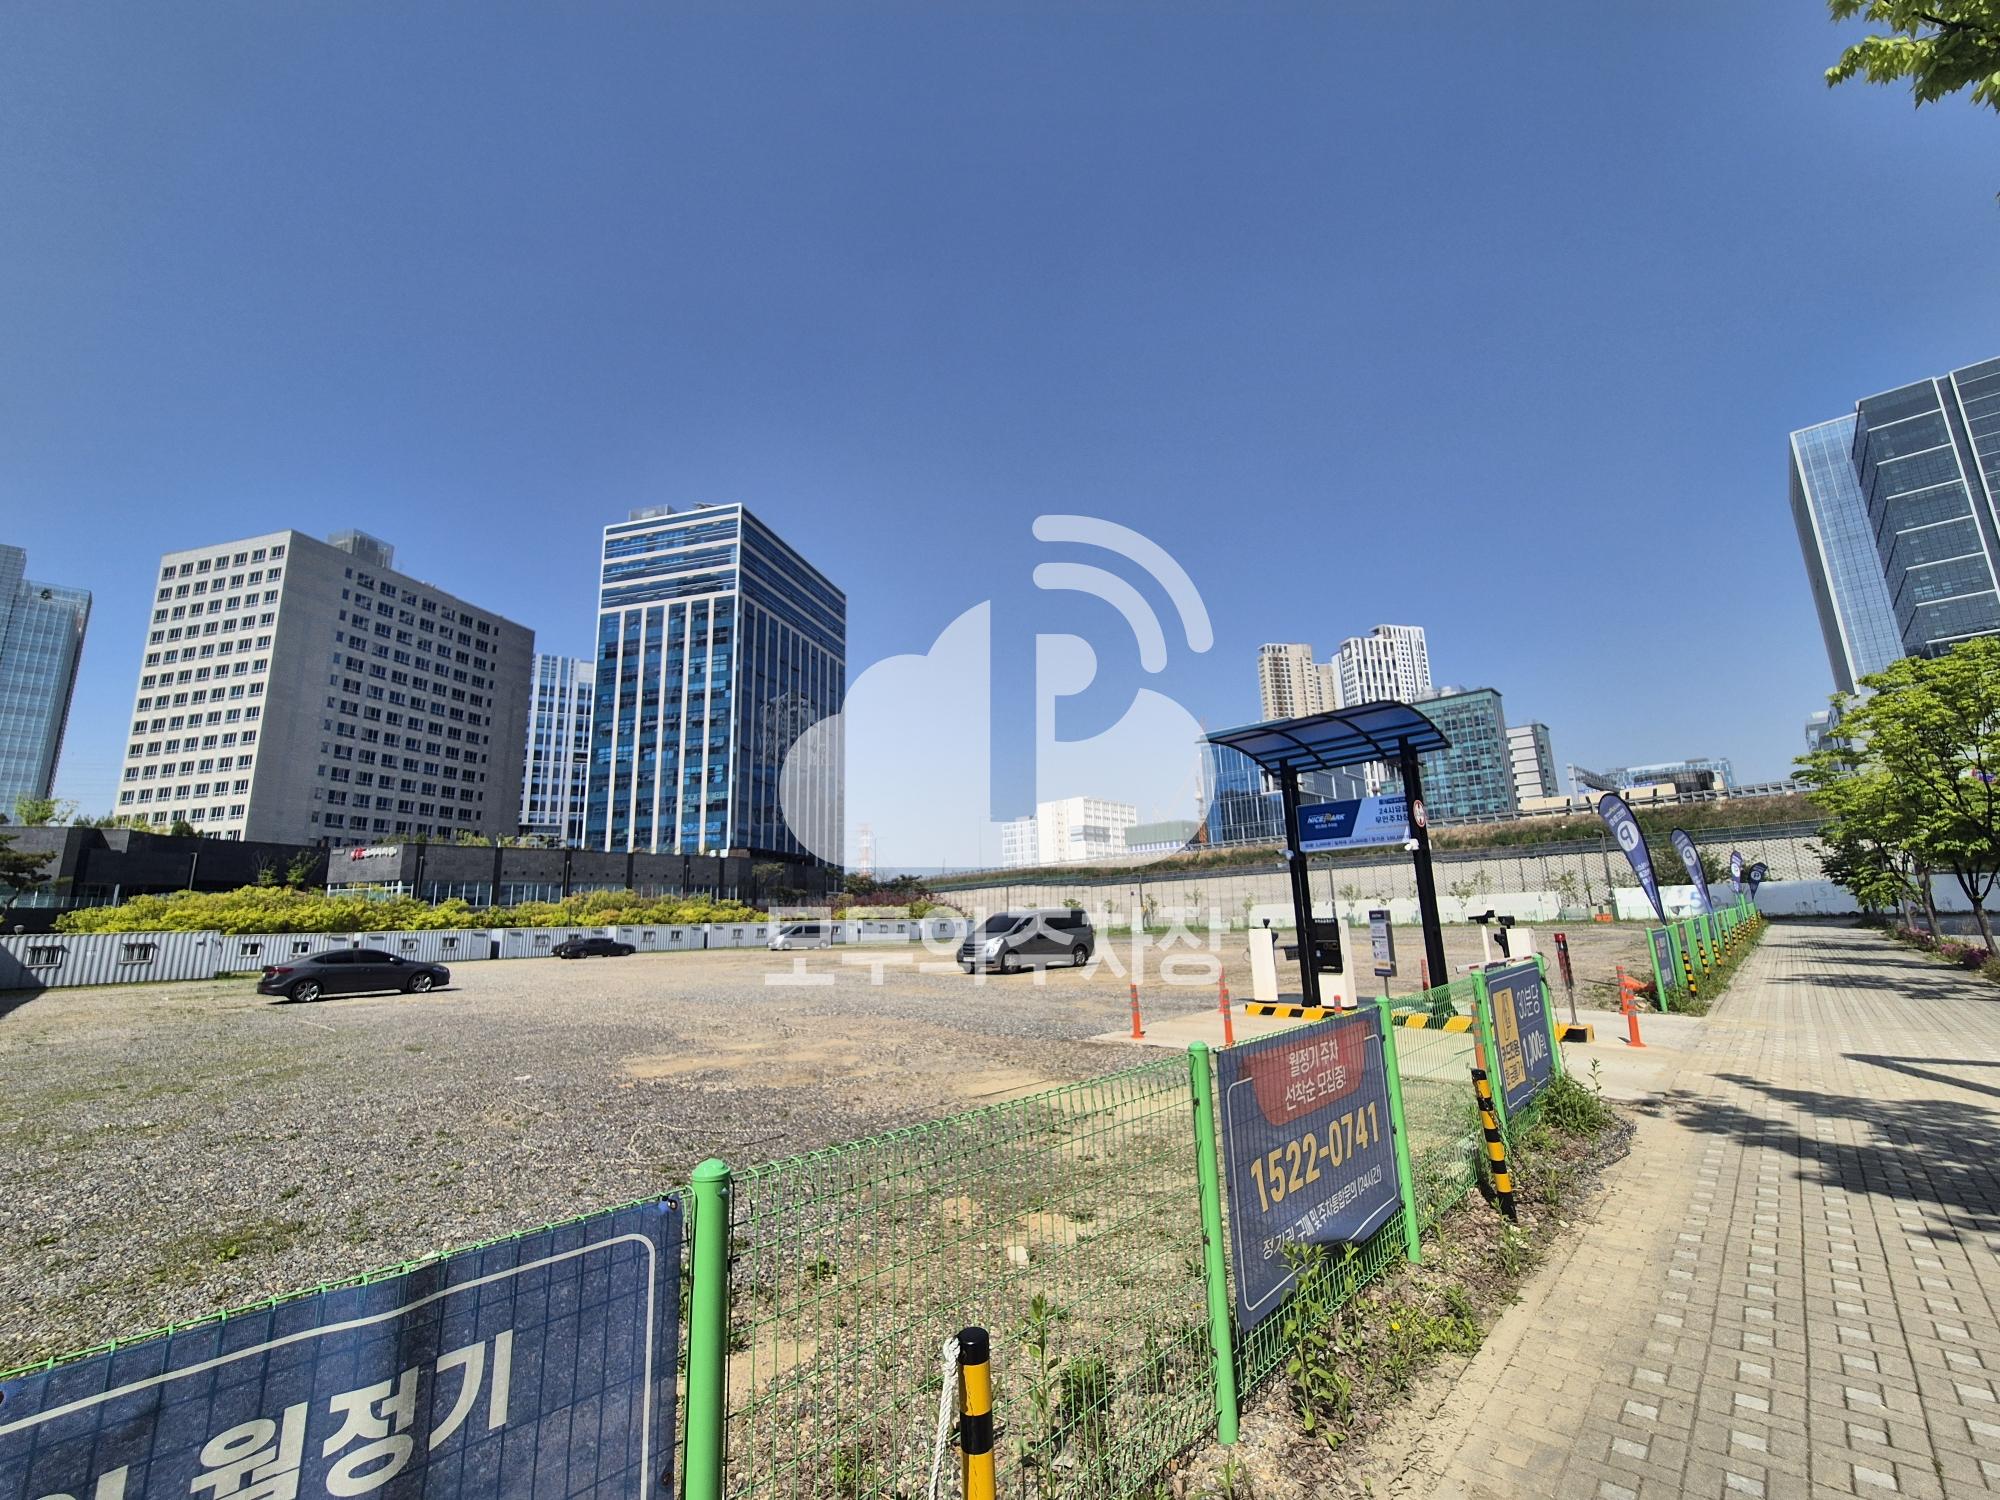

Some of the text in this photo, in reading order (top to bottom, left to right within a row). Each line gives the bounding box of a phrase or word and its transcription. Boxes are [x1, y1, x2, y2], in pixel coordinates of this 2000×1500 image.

[1516, 983, 1541, 1020] 30분당
[1289, 1038, 1339, 1078] 월정기 주차
[1285, 1065, 1347, 1111] 선착순 모집중!
[1250, 1101, 1380, 1213] 1522-0741
[190, 1329, 513, 1500] 월정기
